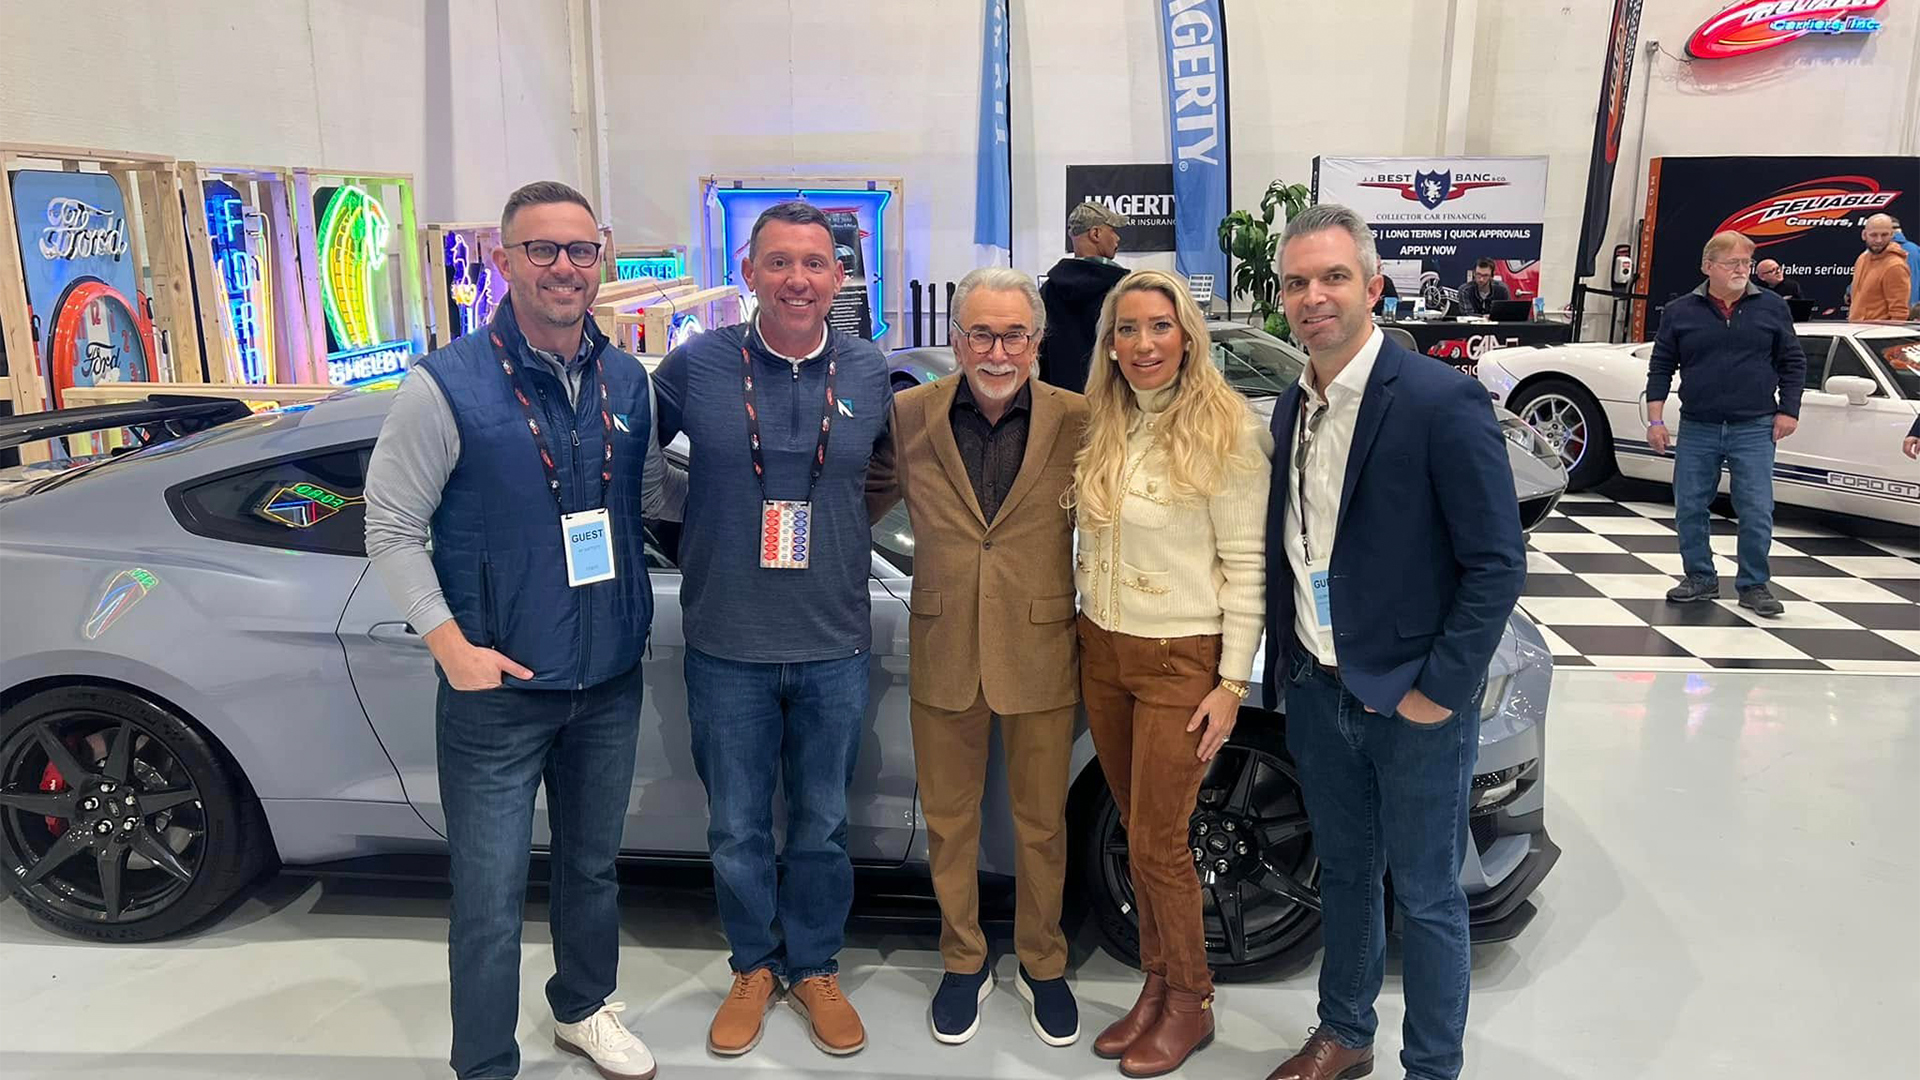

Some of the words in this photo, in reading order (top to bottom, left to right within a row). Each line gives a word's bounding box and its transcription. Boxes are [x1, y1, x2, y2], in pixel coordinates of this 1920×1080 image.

[1378, 174, 1412, 182] BEST
[1455, 173, 1491, 182] BANC
[1085, 194, 1176, 215] AGERT
[1764, 193, 1893, 219] RELIABLE
[1786, 217, 1852, 228] Carriers,
[1385, 229, 1409, 239] LONG
[1410, 229, 1442, 239] TERMS
[1450, 229, 1479, 239] QUICK
[1479, 229, 1531, 239] APPROVALS
[1400, 245, 1431, 255] APPLY
[1432, 245, 1457, 255] NOW
[618, 263, 675, 281] MASTER
[81, 342, 121, 378] Ford
[328, 349, 408, 385] SHELBY
[1829, 473, 1884, 490] FORD
[1888, 482, 1917, 495] GT
[571, 528, 603, 543] GUEST
